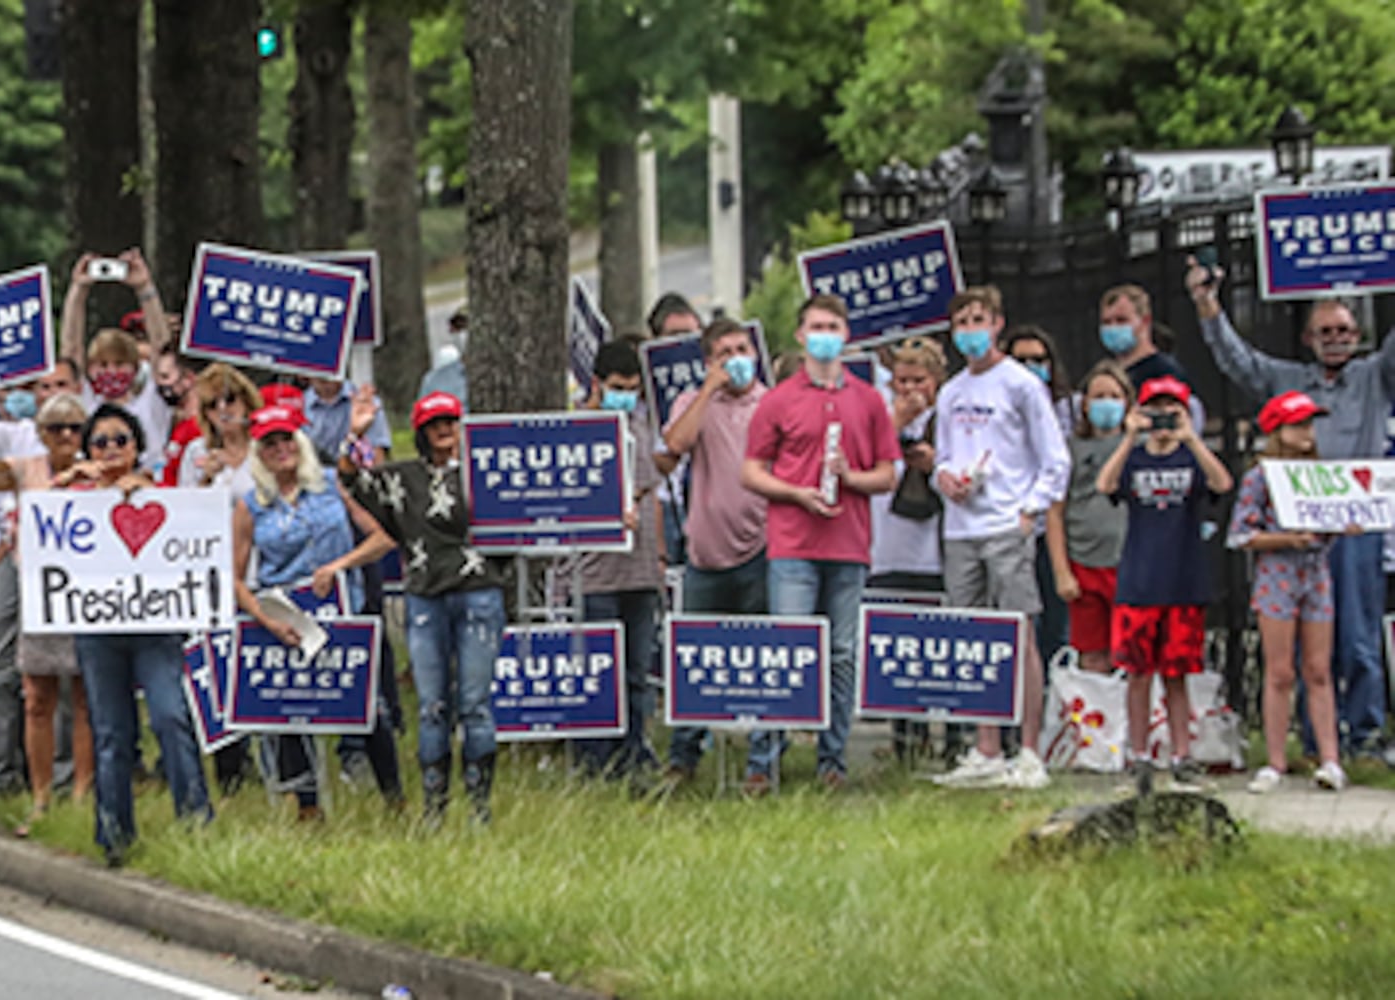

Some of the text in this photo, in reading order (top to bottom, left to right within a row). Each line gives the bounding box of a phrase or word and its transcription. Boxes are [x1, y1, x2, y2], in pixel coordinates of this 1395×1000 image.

[813, 250, 946, 295] TRUMP
[205, 276, 344, 319] TRUMP
[854, 275, 940, 307] ENCE
[210, 301, 328, 336] PENCE
[472, 443, 615, 471] TRUMP
[486, 468, 603, 489] PENCE
[1284, 464, 1351, 496] KIDS
[32, 501, 222, 562] We our
[41, 566, 221, 626] President!
[241, 645, 369, 669] TRUMP
[676, 645, 818, 669] TRUMP
[869, 634, 1013, 664] TRUMP
[249, 670, 354, 688] PENCE
[494, 653, 613, 680] RUMP
[687, 668, 804, 688] PENCE
[880, 659, 999, 682] PENCE
